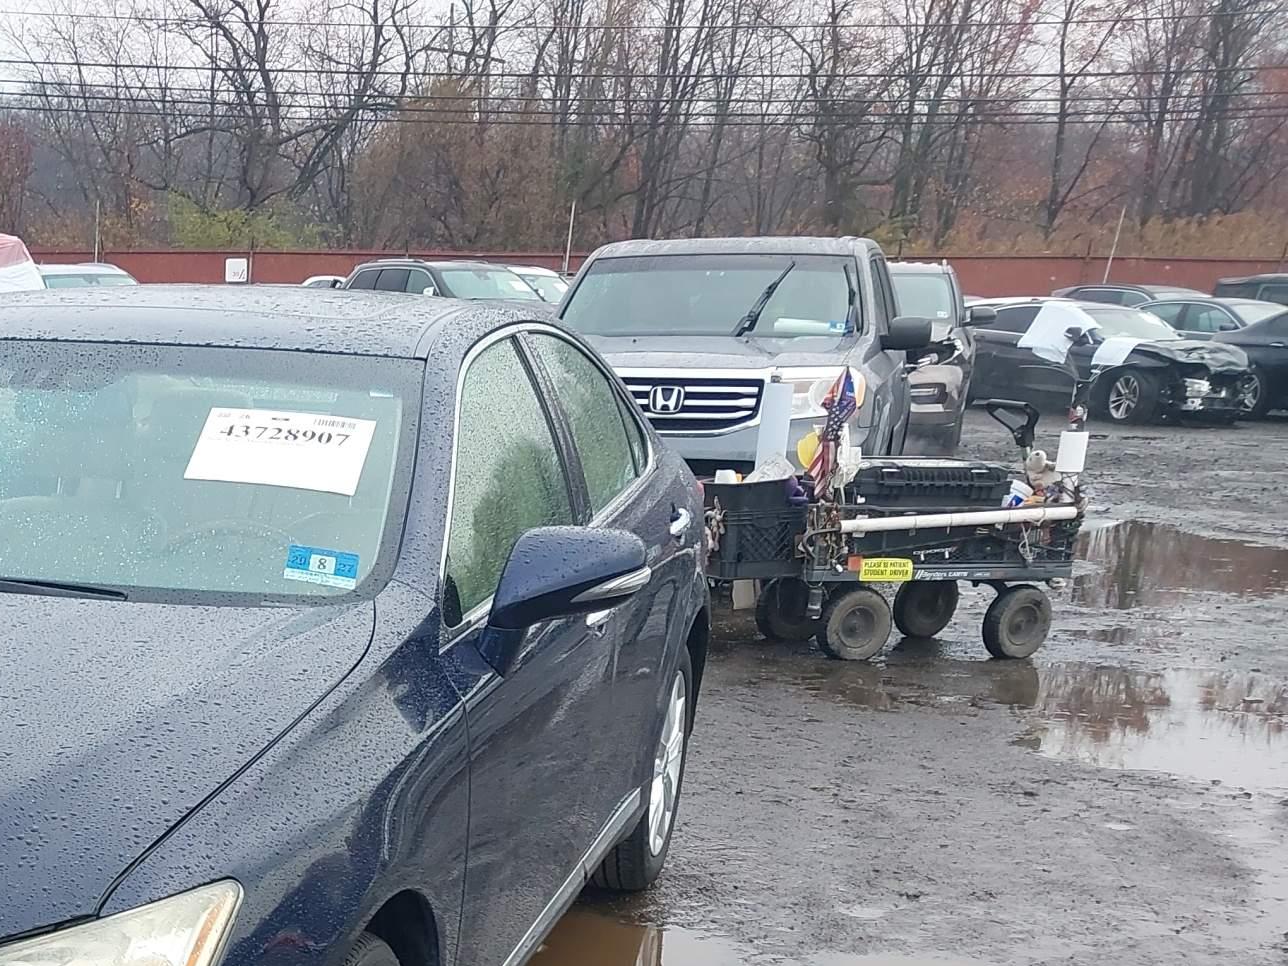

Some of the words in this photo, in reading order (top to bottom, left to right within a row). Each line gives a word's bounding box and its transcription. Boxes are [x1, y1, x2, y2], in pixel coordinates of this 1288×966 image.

[220, 424, 352, 447] 43728907
[317, 558, 327, 570] 8
[889, 569, 909, 577] DRIVER
